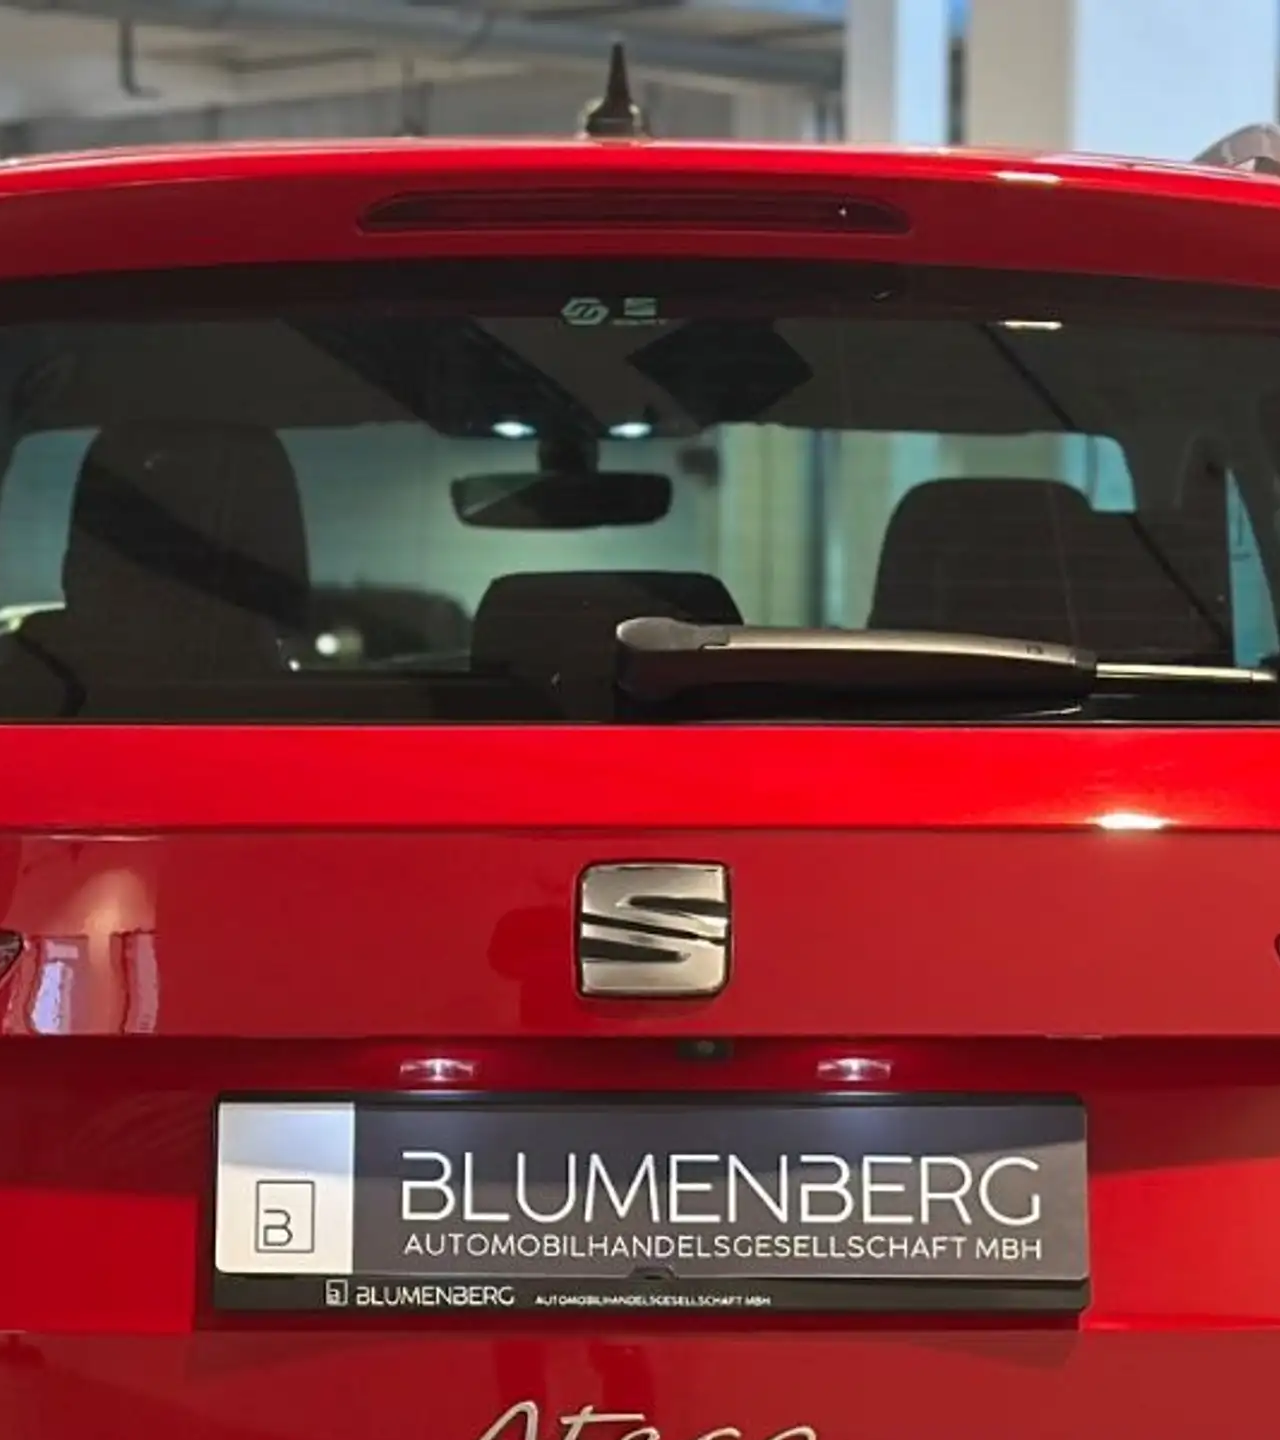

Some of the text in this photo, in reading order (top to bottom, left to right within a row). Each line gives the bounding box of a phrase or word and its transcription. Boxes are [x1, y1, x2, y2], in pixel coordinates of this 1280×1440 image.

[401, 1151, 1041, 1226] BLUMENBERG
[262, 1208, 294, 1248] B
[403, 1233, 1042, 1260] AUTOMOBILHANDELSGESELLSCHAFT MBH
[355, 1285, 516, 1307] BLUMENBERG
